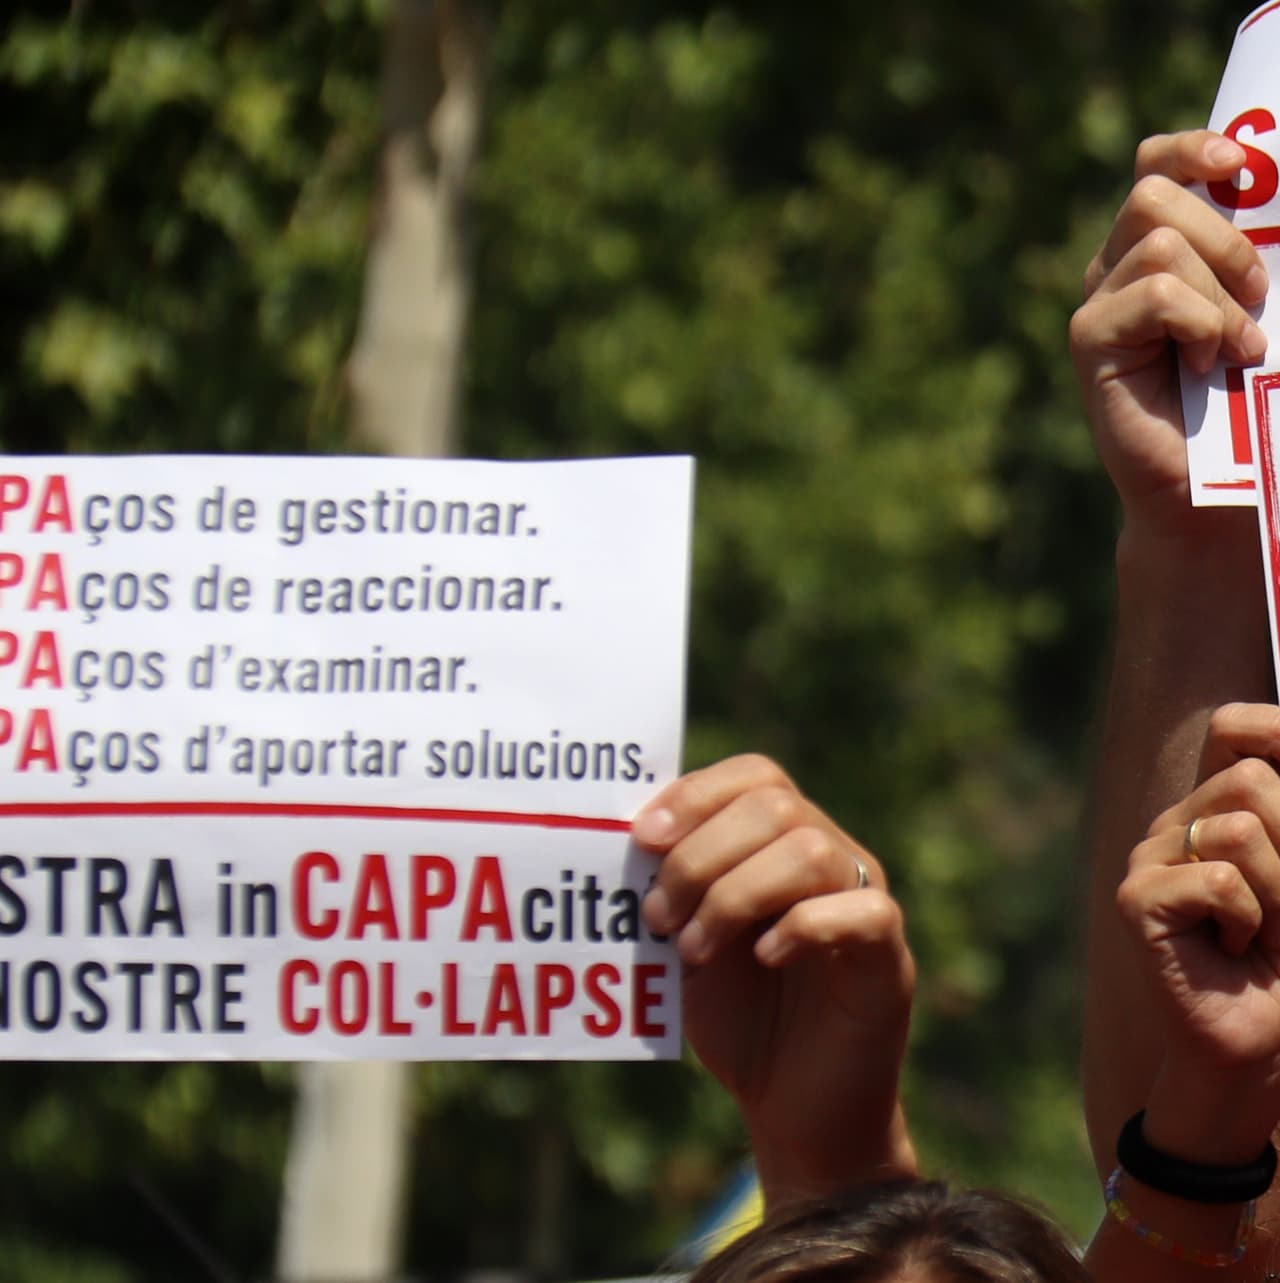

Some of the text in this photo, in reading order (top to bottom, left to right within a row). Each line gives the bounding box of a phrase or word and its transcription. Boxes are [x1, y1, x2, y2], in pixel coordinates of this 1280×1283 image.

[199, 486, 256, 533] de
[280, 488, 539, 546] gestionar.
[191, 565, 251, 612] de
[274, 565, 563, 612] reaccionar.
[425, 731, 656, 783] solucions.
[217, 852, 670, 943] inCAPAcita
[0, 960, 246, 1034] OSTRE
